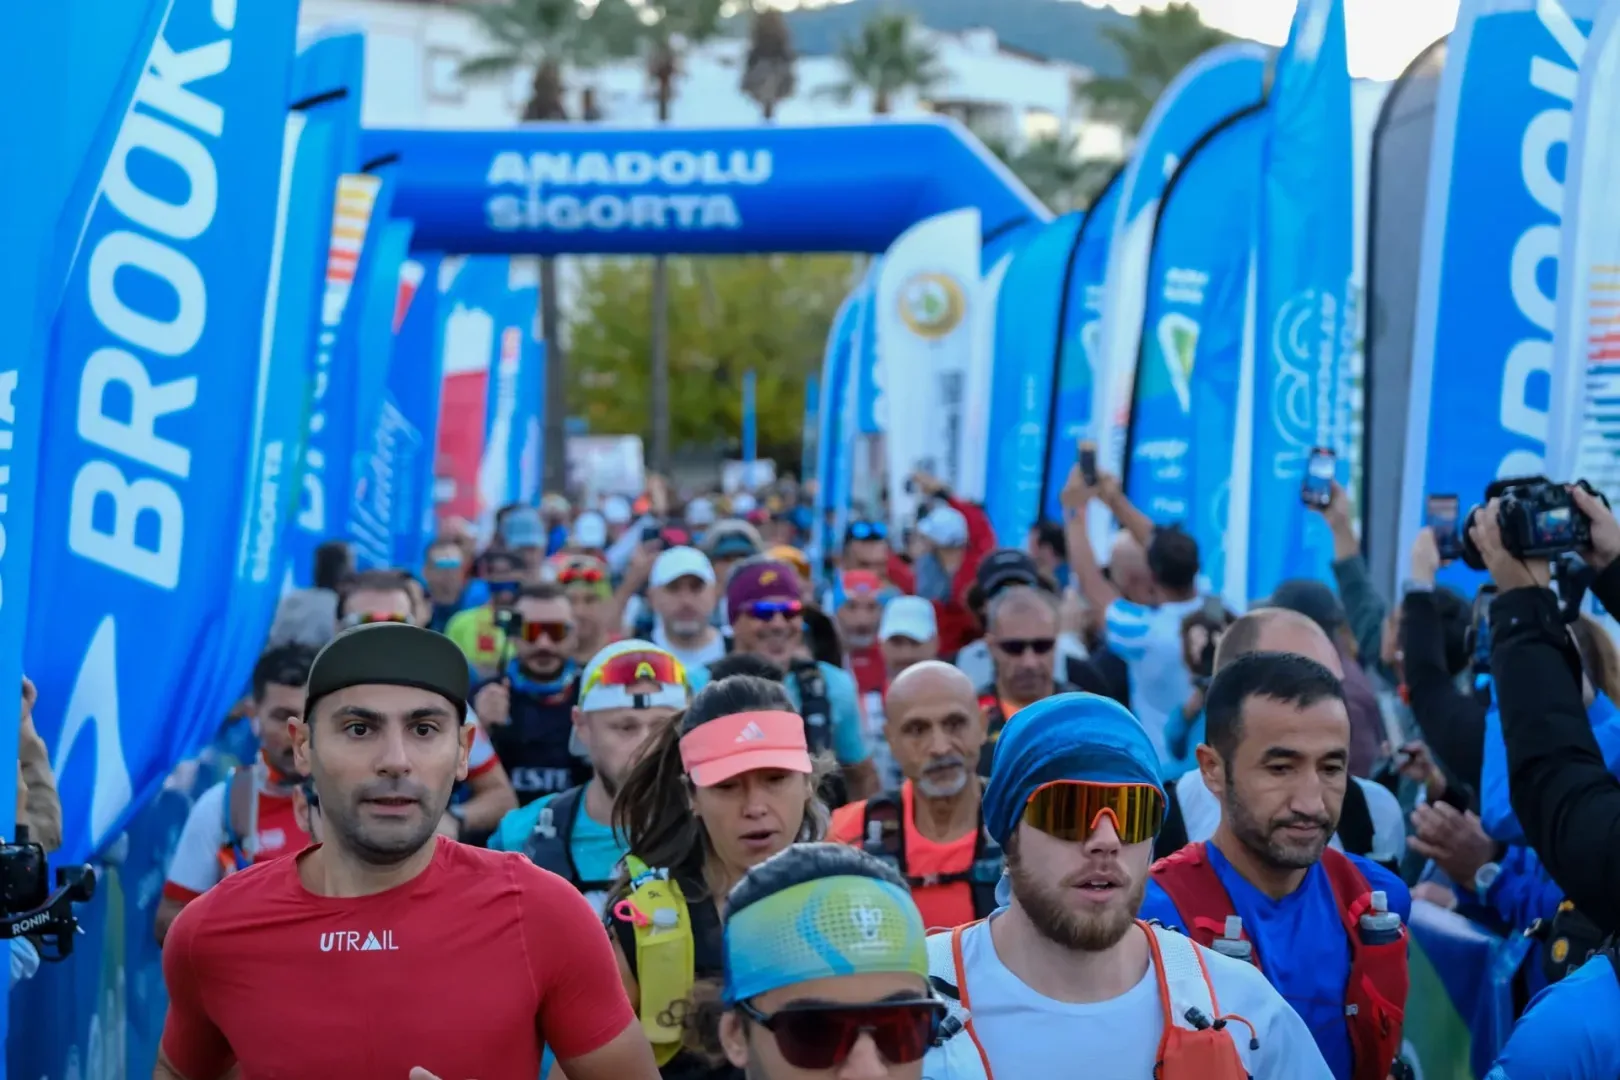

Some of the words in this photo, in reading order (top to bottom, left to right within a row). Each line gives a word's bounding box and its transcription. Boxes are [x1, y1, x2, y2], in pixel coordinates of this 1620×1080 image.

[486, 149, 773, 187] ANADOLU
[68, 0, 238, 590] BROOK
[11, 910, 50, 936] RONIN
